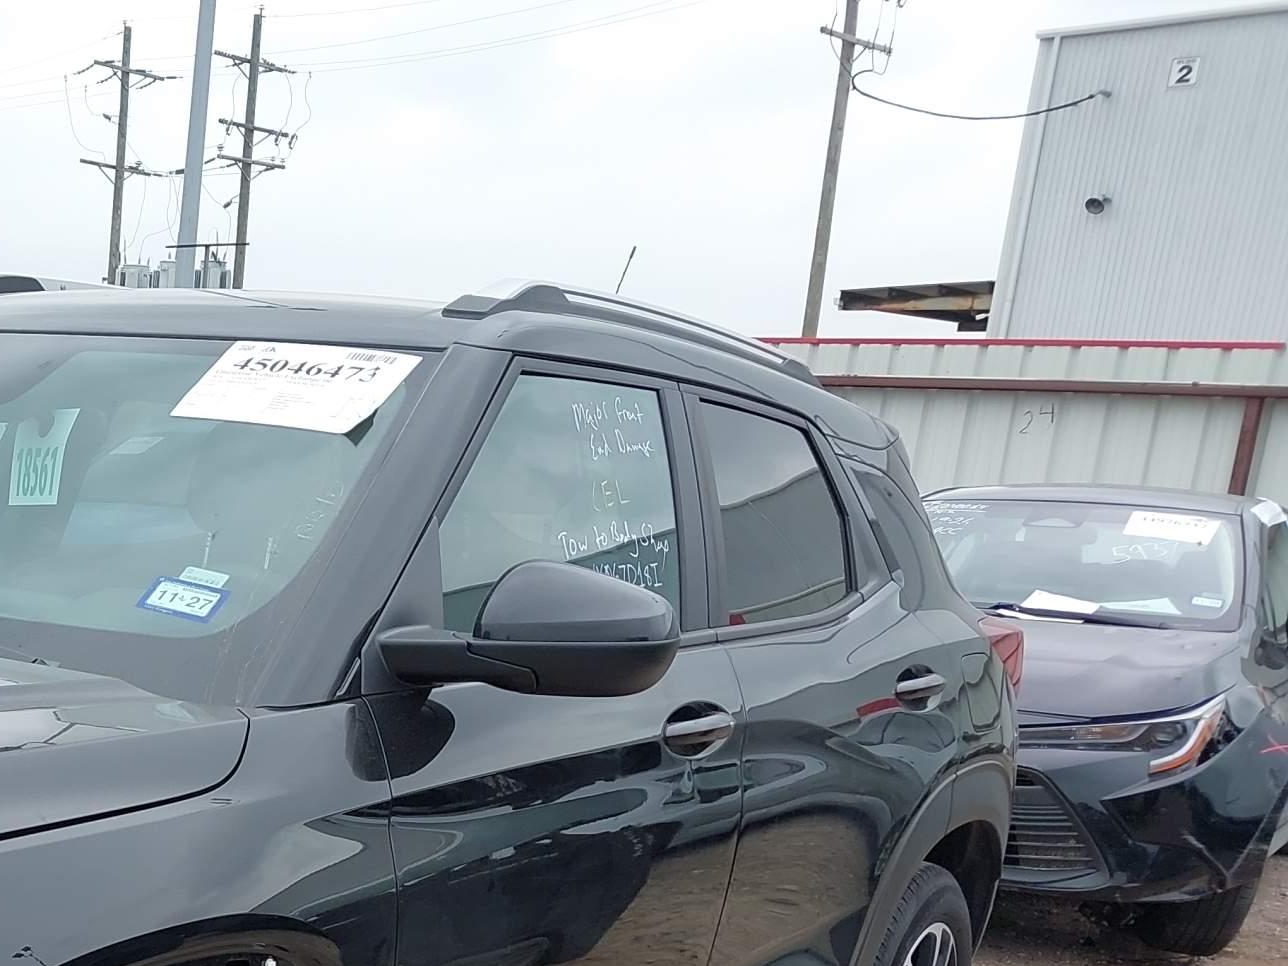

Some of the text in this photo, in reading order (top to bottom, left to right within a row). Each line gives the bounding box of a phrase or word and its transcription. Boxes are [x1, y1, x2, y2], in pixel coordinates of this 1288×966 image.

[1174, 64, 1193, 84] 2
[571, 400, 608, 432] Major
[15, 446, 60, 497] 18561
[557, 532, 588, 560] Tow
[592, 526, 608, 550] to
